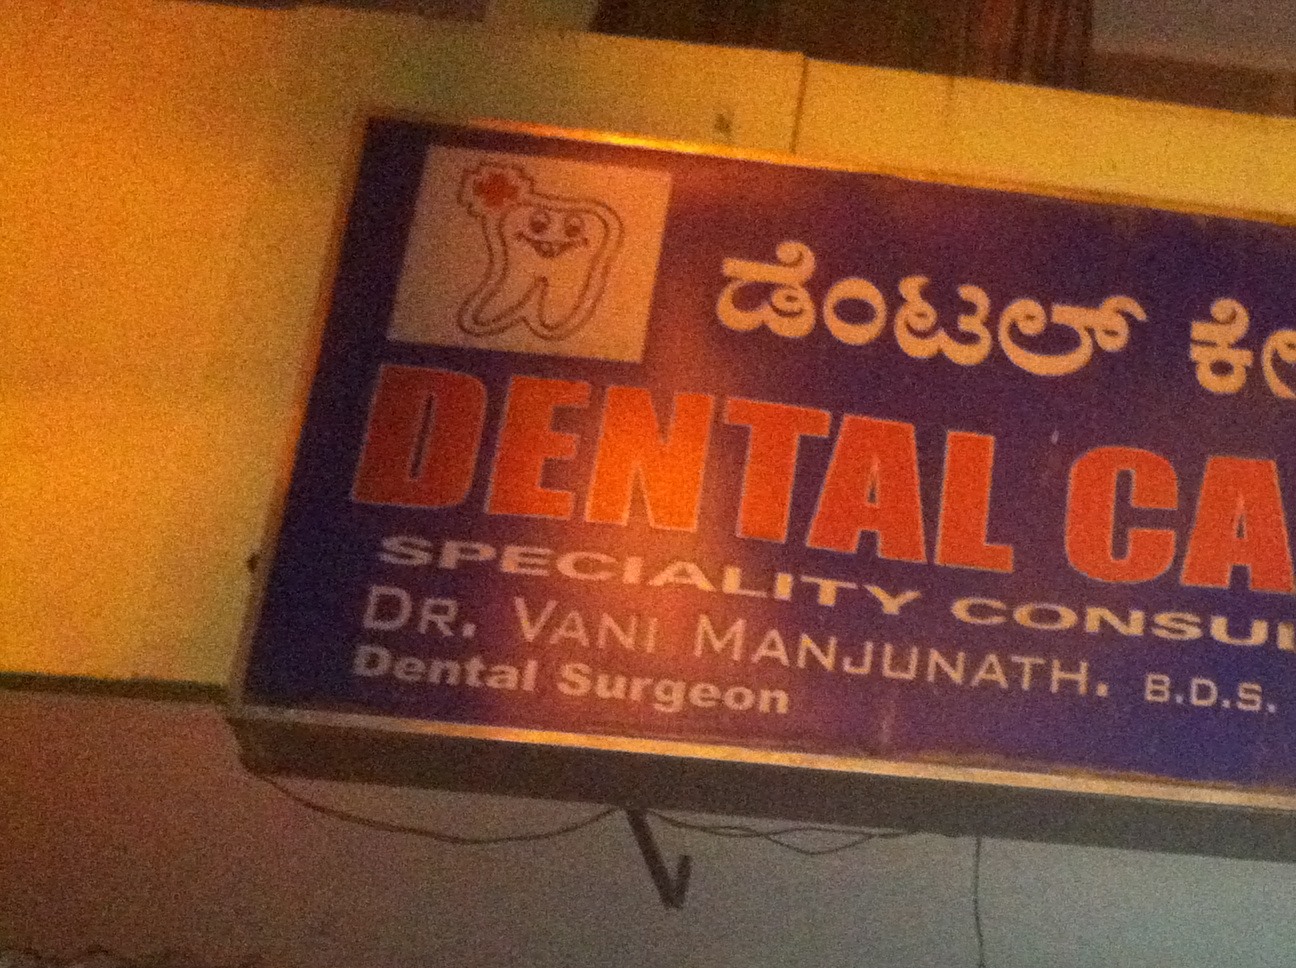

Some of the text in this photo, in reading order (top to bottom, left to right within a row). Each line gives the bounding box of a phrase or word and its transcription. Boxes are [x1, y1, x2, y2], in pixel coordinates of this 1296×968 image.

[351, 364, 1015, 573] DENTAL
[378, 535, 922, 616] SPECIALITY
[353, 643, 790, 714] Dental Surgeon
[362, 584, 1277, 714] DR. VANI MANJUNATH. B.D.S.
